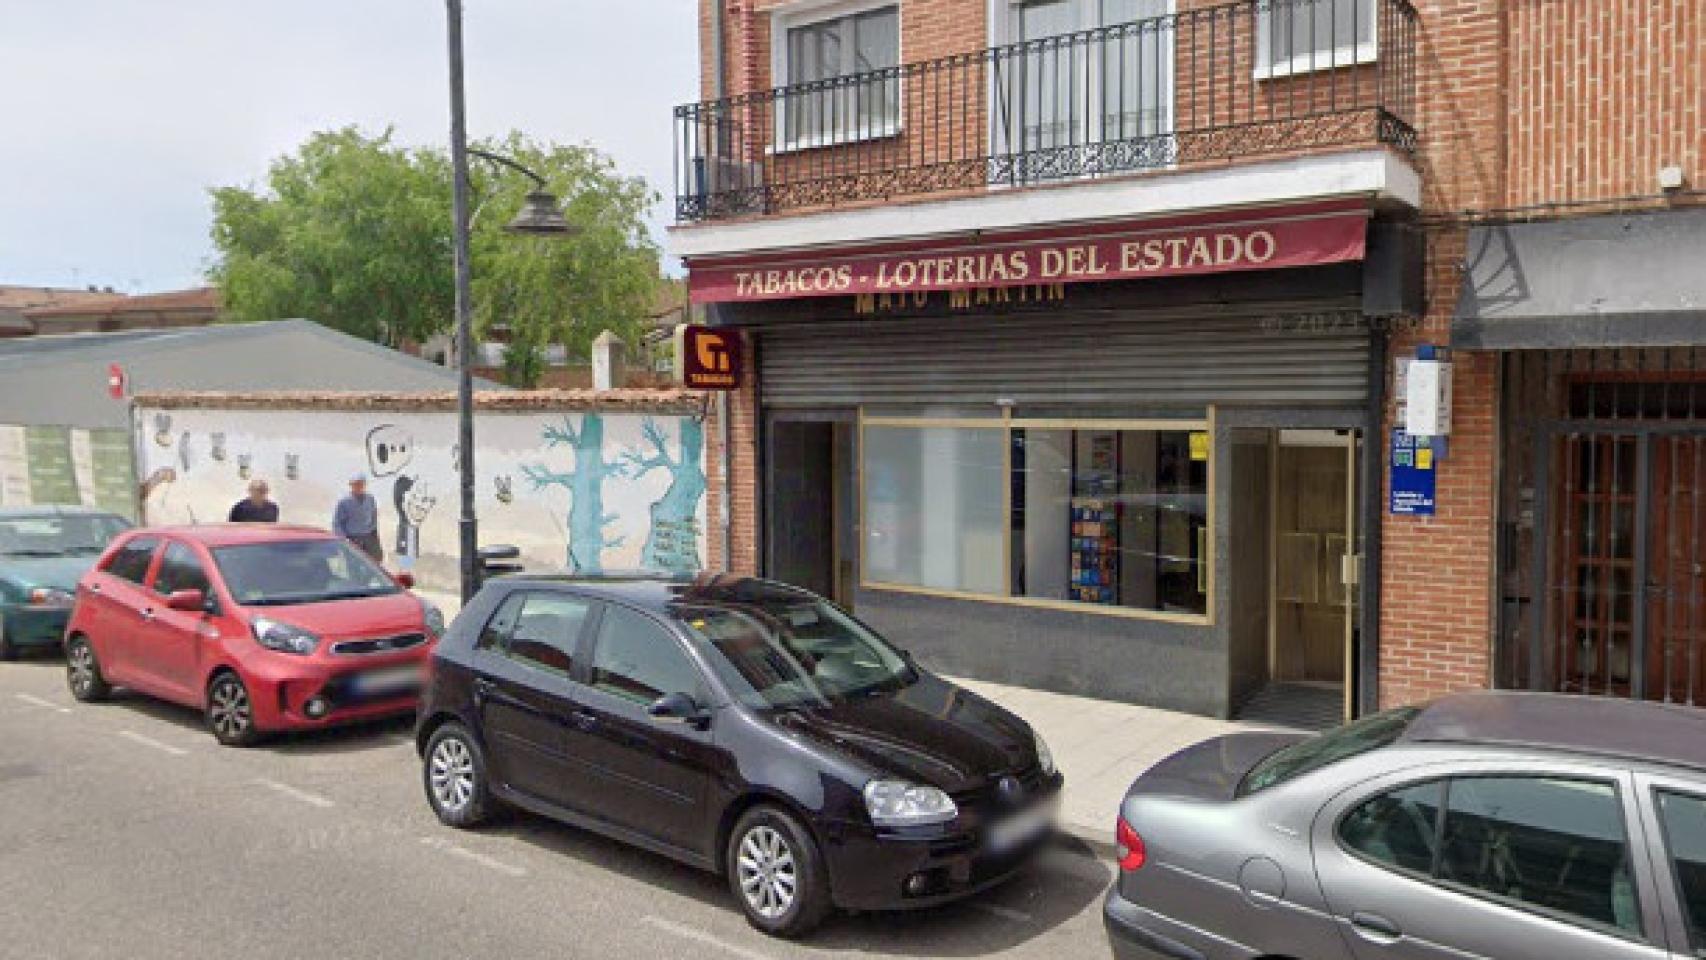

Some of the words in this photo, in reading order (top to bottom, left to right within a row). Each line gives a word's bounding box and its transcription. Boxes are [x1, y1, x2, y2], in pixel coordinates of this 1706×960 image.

[736, 264, 851, 296] TABACOS
[876, 251, 1029, 288] LOTERIAS
[1040, 245, 1109, 277] DEL
[1120, 231, 1277, 272] ESTADO
